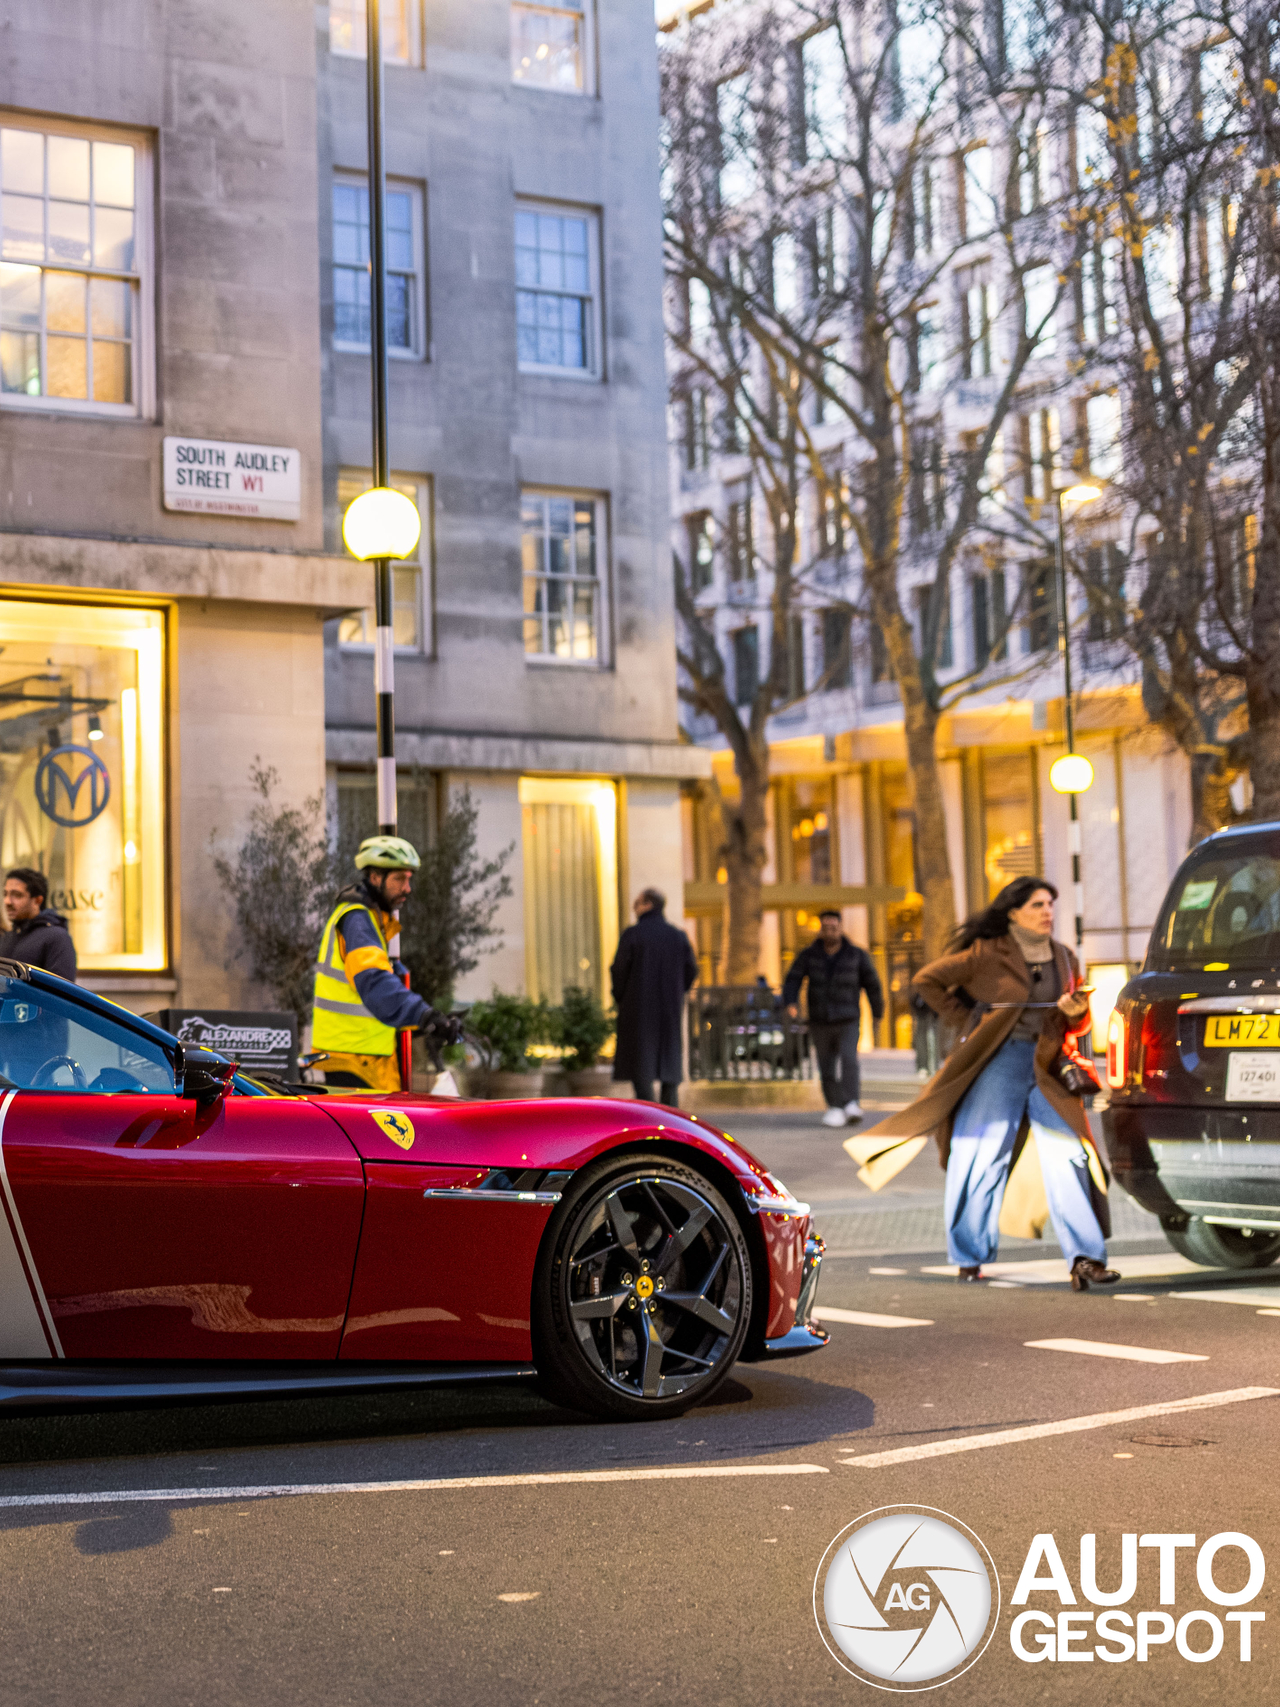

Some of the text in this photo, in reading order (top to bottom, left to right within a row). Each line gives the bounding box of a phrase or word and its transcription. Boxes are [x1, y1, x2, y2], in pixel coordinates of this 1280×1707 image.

[176, 445, 290, 474] SOUTH AUDLEY
[176, 468, 264, 493] STREET W1
[200, 1029, 269, 1042] ALEXANDRE
[1215, 1019, 1270, 1040] LM72
